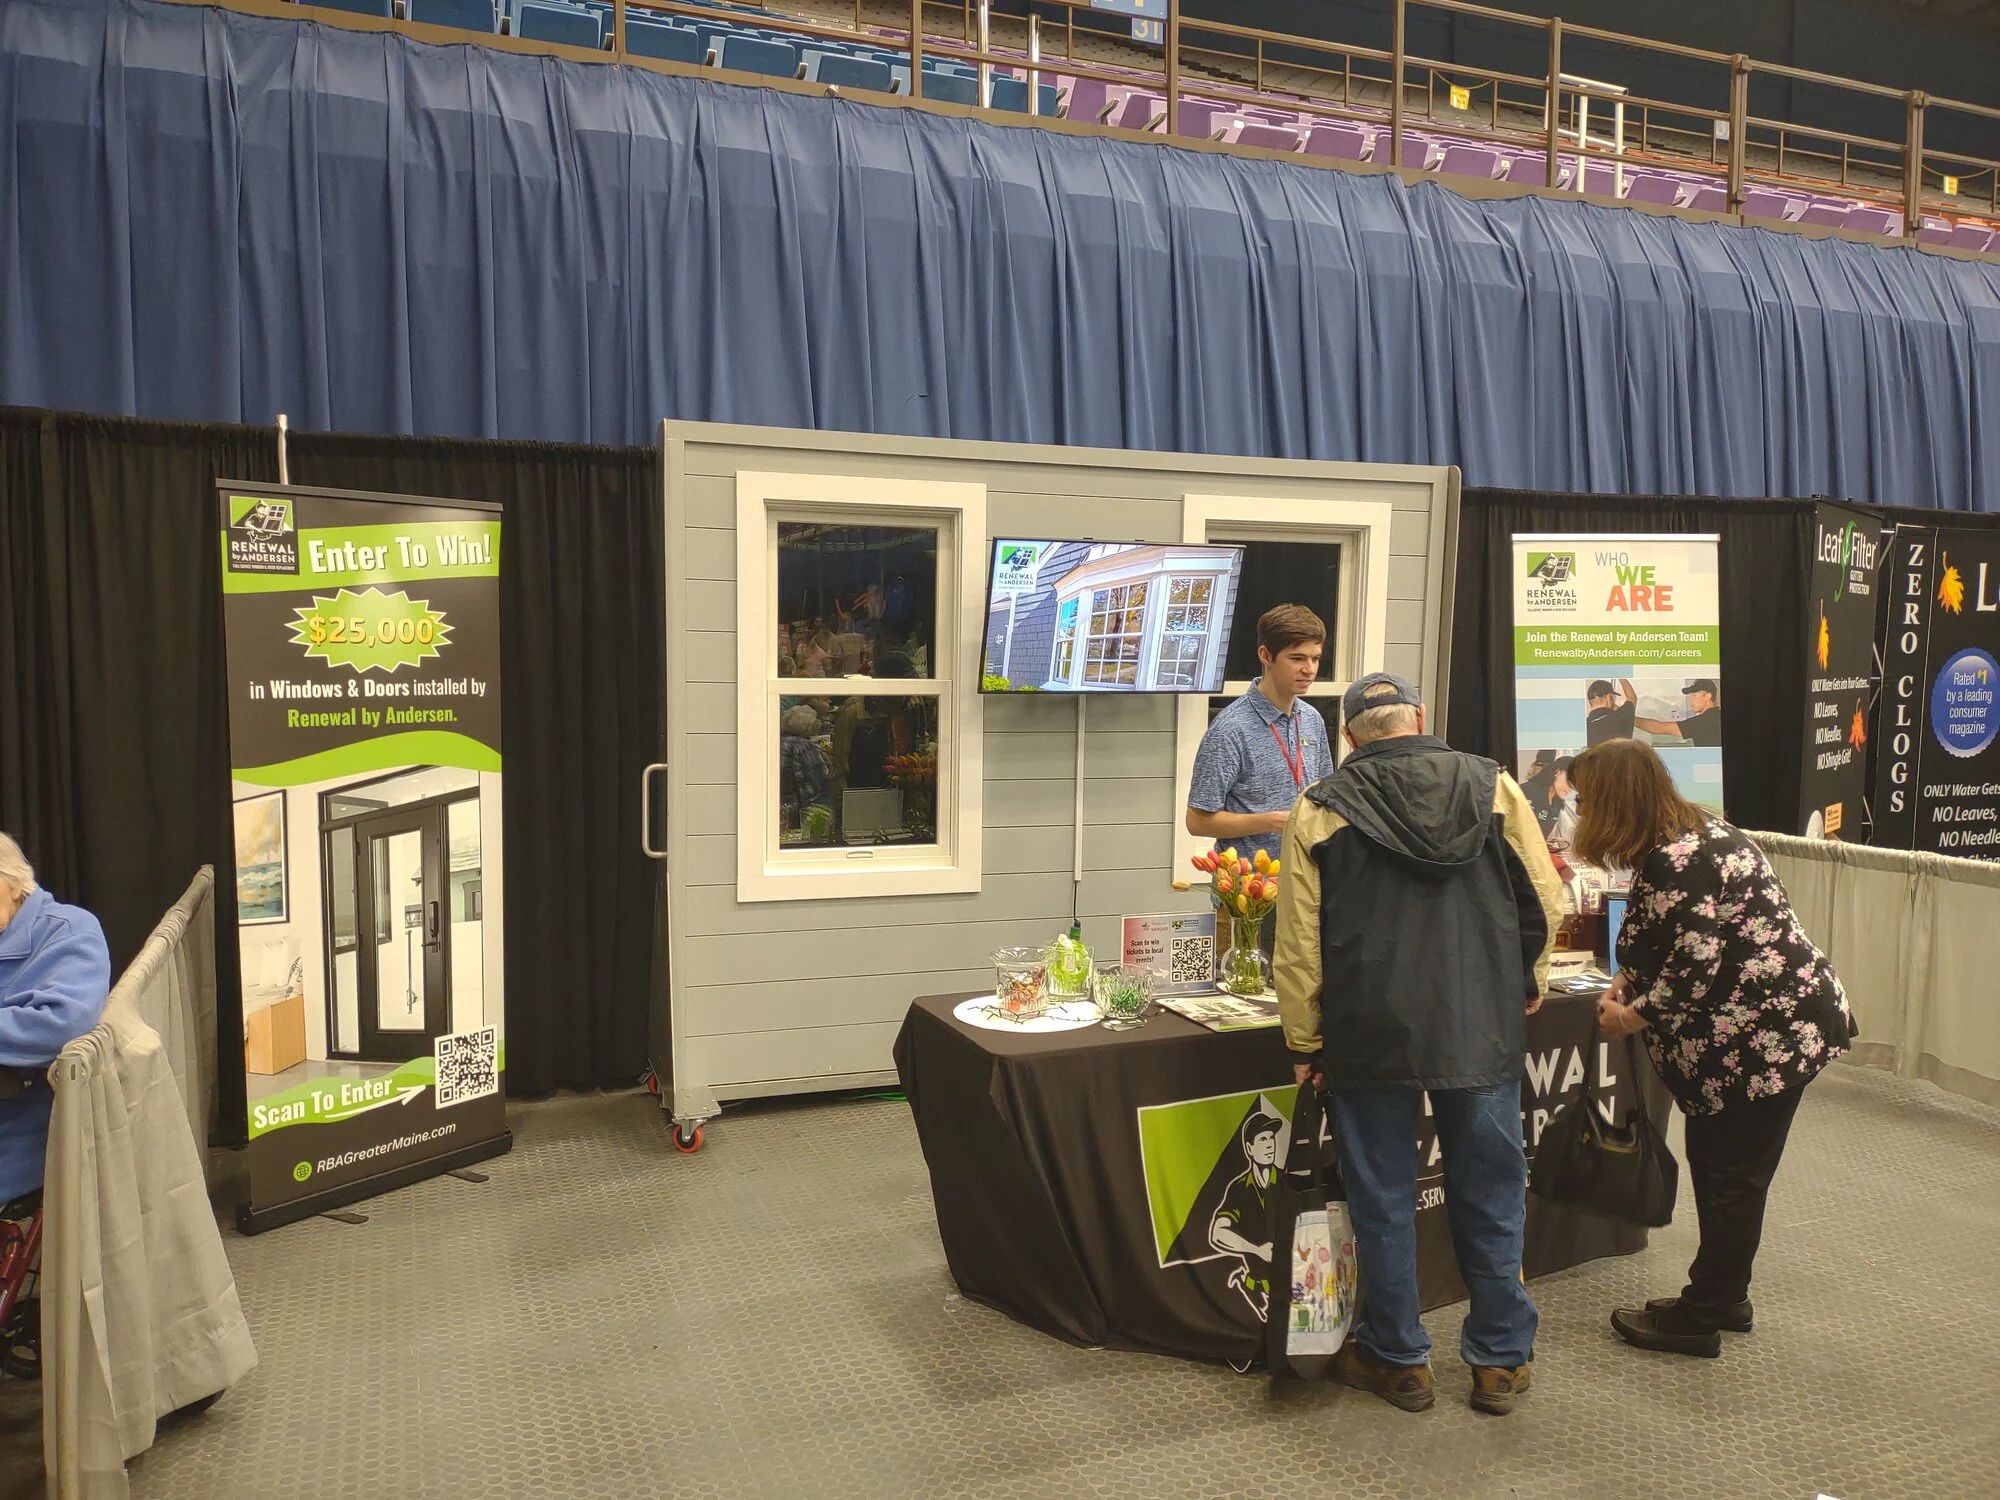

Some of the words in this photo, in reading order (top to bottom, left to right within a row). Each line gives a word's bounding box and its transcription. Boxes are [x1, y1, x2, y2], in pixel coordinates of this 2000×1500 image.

[1134, 19, 1159, 40] 31
[231, 541, 295, 555] RENEWAL
[308, 539, 388, 574] Enter
[395, 535, 429, 568] To
[435, 533, 493, 566] Win!
[231, 552, 241, 561] by
[241, 553, 295, 563] ANDERSEN
[1595, 552, 1628, 567] WHO
[999, 572, 1034, 580] RENEWAL
[1615, 565, 1656, 586] WE
[1527, 589, 1577, 598] RENEWAL
[1606, 585, 1674, 612] ARE
[1900, 544, 1924, 654] ZERO
[309, 614, 435, 648] $25,000
[1525, 631, 1547, 643] Join
[1550, 631, 1567, 643] the
[1570, 631, 1613, 643] Renewal
[1616, 631, 1628, 645] by
[1629, 631, 1677, 643] Andersen
[1679, 631, 1709, 642] Team!
[1534, 647, 1702, 660] RenewalbyAndersen.com/careers
[1953, 671, 1975, 685] Rated
[1977, 669, 1988, 685] #1
[250, 681, 265, 699] in
[270, 680, 342, 699] Windows
[347, 680, 360, 698] &
[364, 679, 410, 698] Doors
[413, 678, 467, 696] installed
[471, 678, 486, 698] by
[1946, 688, 1956, 705] by
[1957, 691, 1963, 702] a
[1964, 688, 1993, 704] leading
[287, 708, 356, 728] Renewal
[362, 707, 381, 728] by
[385, 706, 458, 725] Andersen.
[1814, 702, 1823, 719] NO
[1949, 707, 1988, 718] consumer
[1815, 727, 1825, 745] NO
[1949, 720, 1986, 737] magazine
[1890, 675, 1913, 813] CLOGS
[1817, 753, 1826, 771] NO
[1923, 784, 1951, 798] ONLY
[1952, 783, 1981, 797] Water
[1932, 806, 1953, 823] NO
[1954, 806, 1998, 822] Leaves,
[1939, 831, 1959, 848] NO
[1960, 828, 2000, 847] Needle
[1131, 939, 1144, 947] Scan
[1151, 938, 1160, 946] win
[1127, 948, 1144, 956] tickets
[253, 1100, 305, 1129] Scan
[311, 1090, 334, 1114] To
[341, 1078, 393, 1106] Enter
[316, 1123, 457, 1174] RBAGreaterMaine.com
